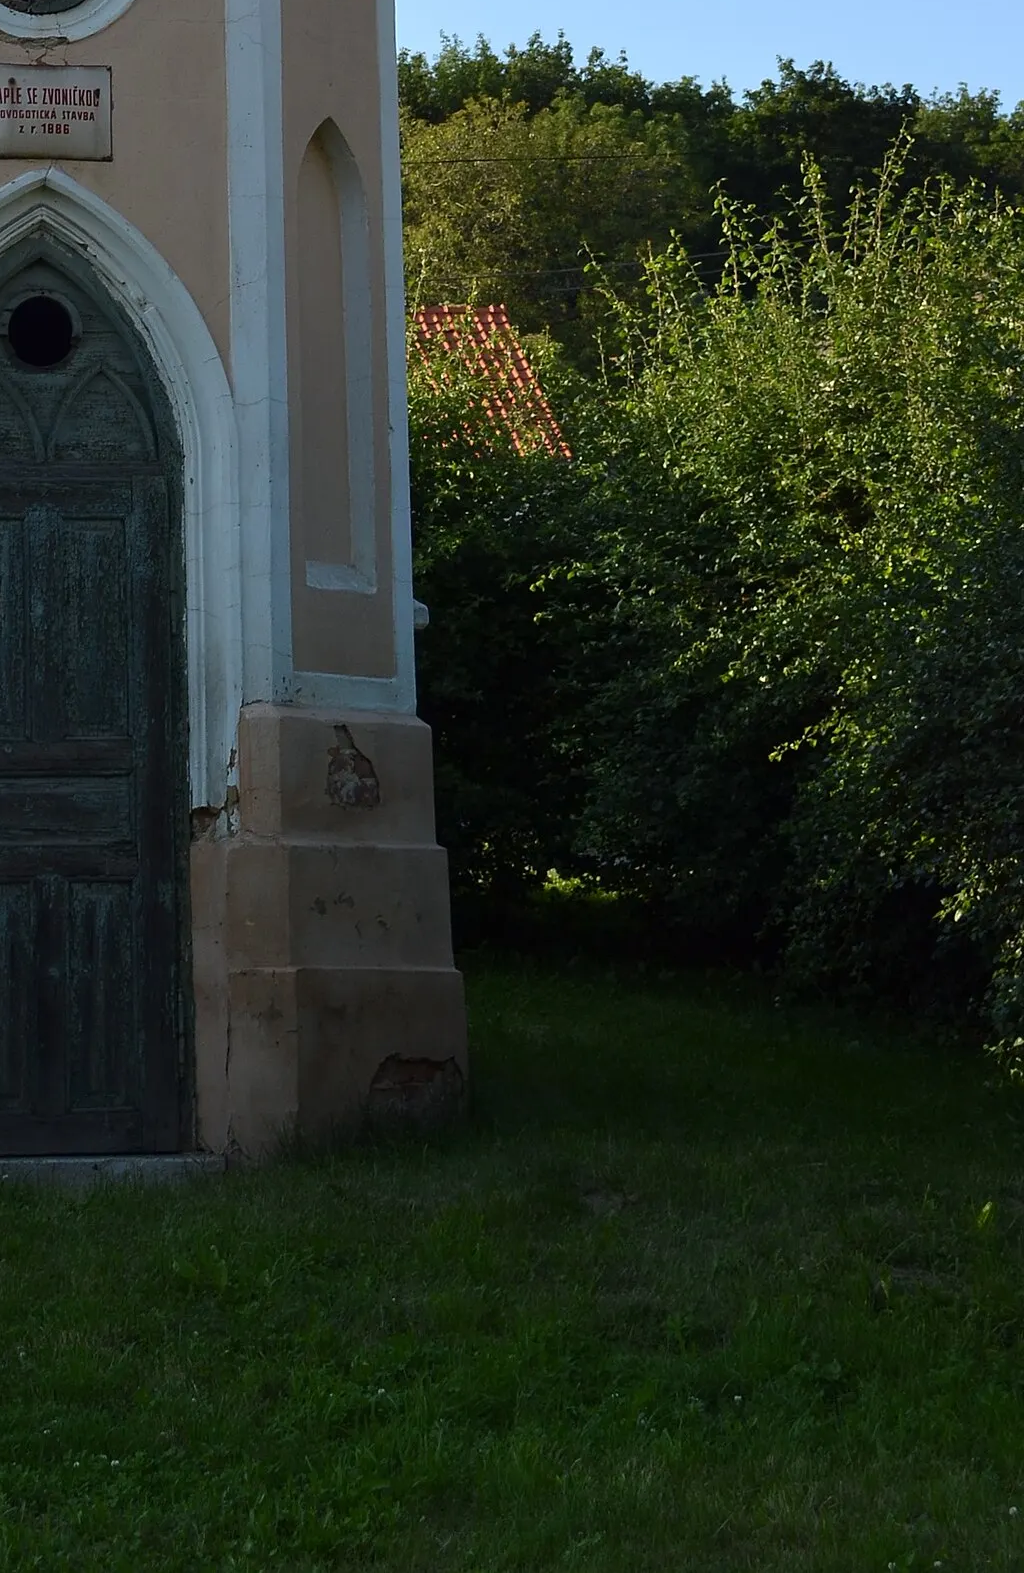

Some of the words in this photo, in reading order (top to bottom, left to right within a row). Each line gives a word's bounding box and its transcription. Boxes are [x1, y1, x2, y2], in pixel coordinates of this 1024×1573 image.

[27, 87, 38, 105] SE
[42, 86, 101, 107] ZVONIČKOU
[62, 110, 95, 121] STAVBA
[40, 123, 70, 135] 1886
